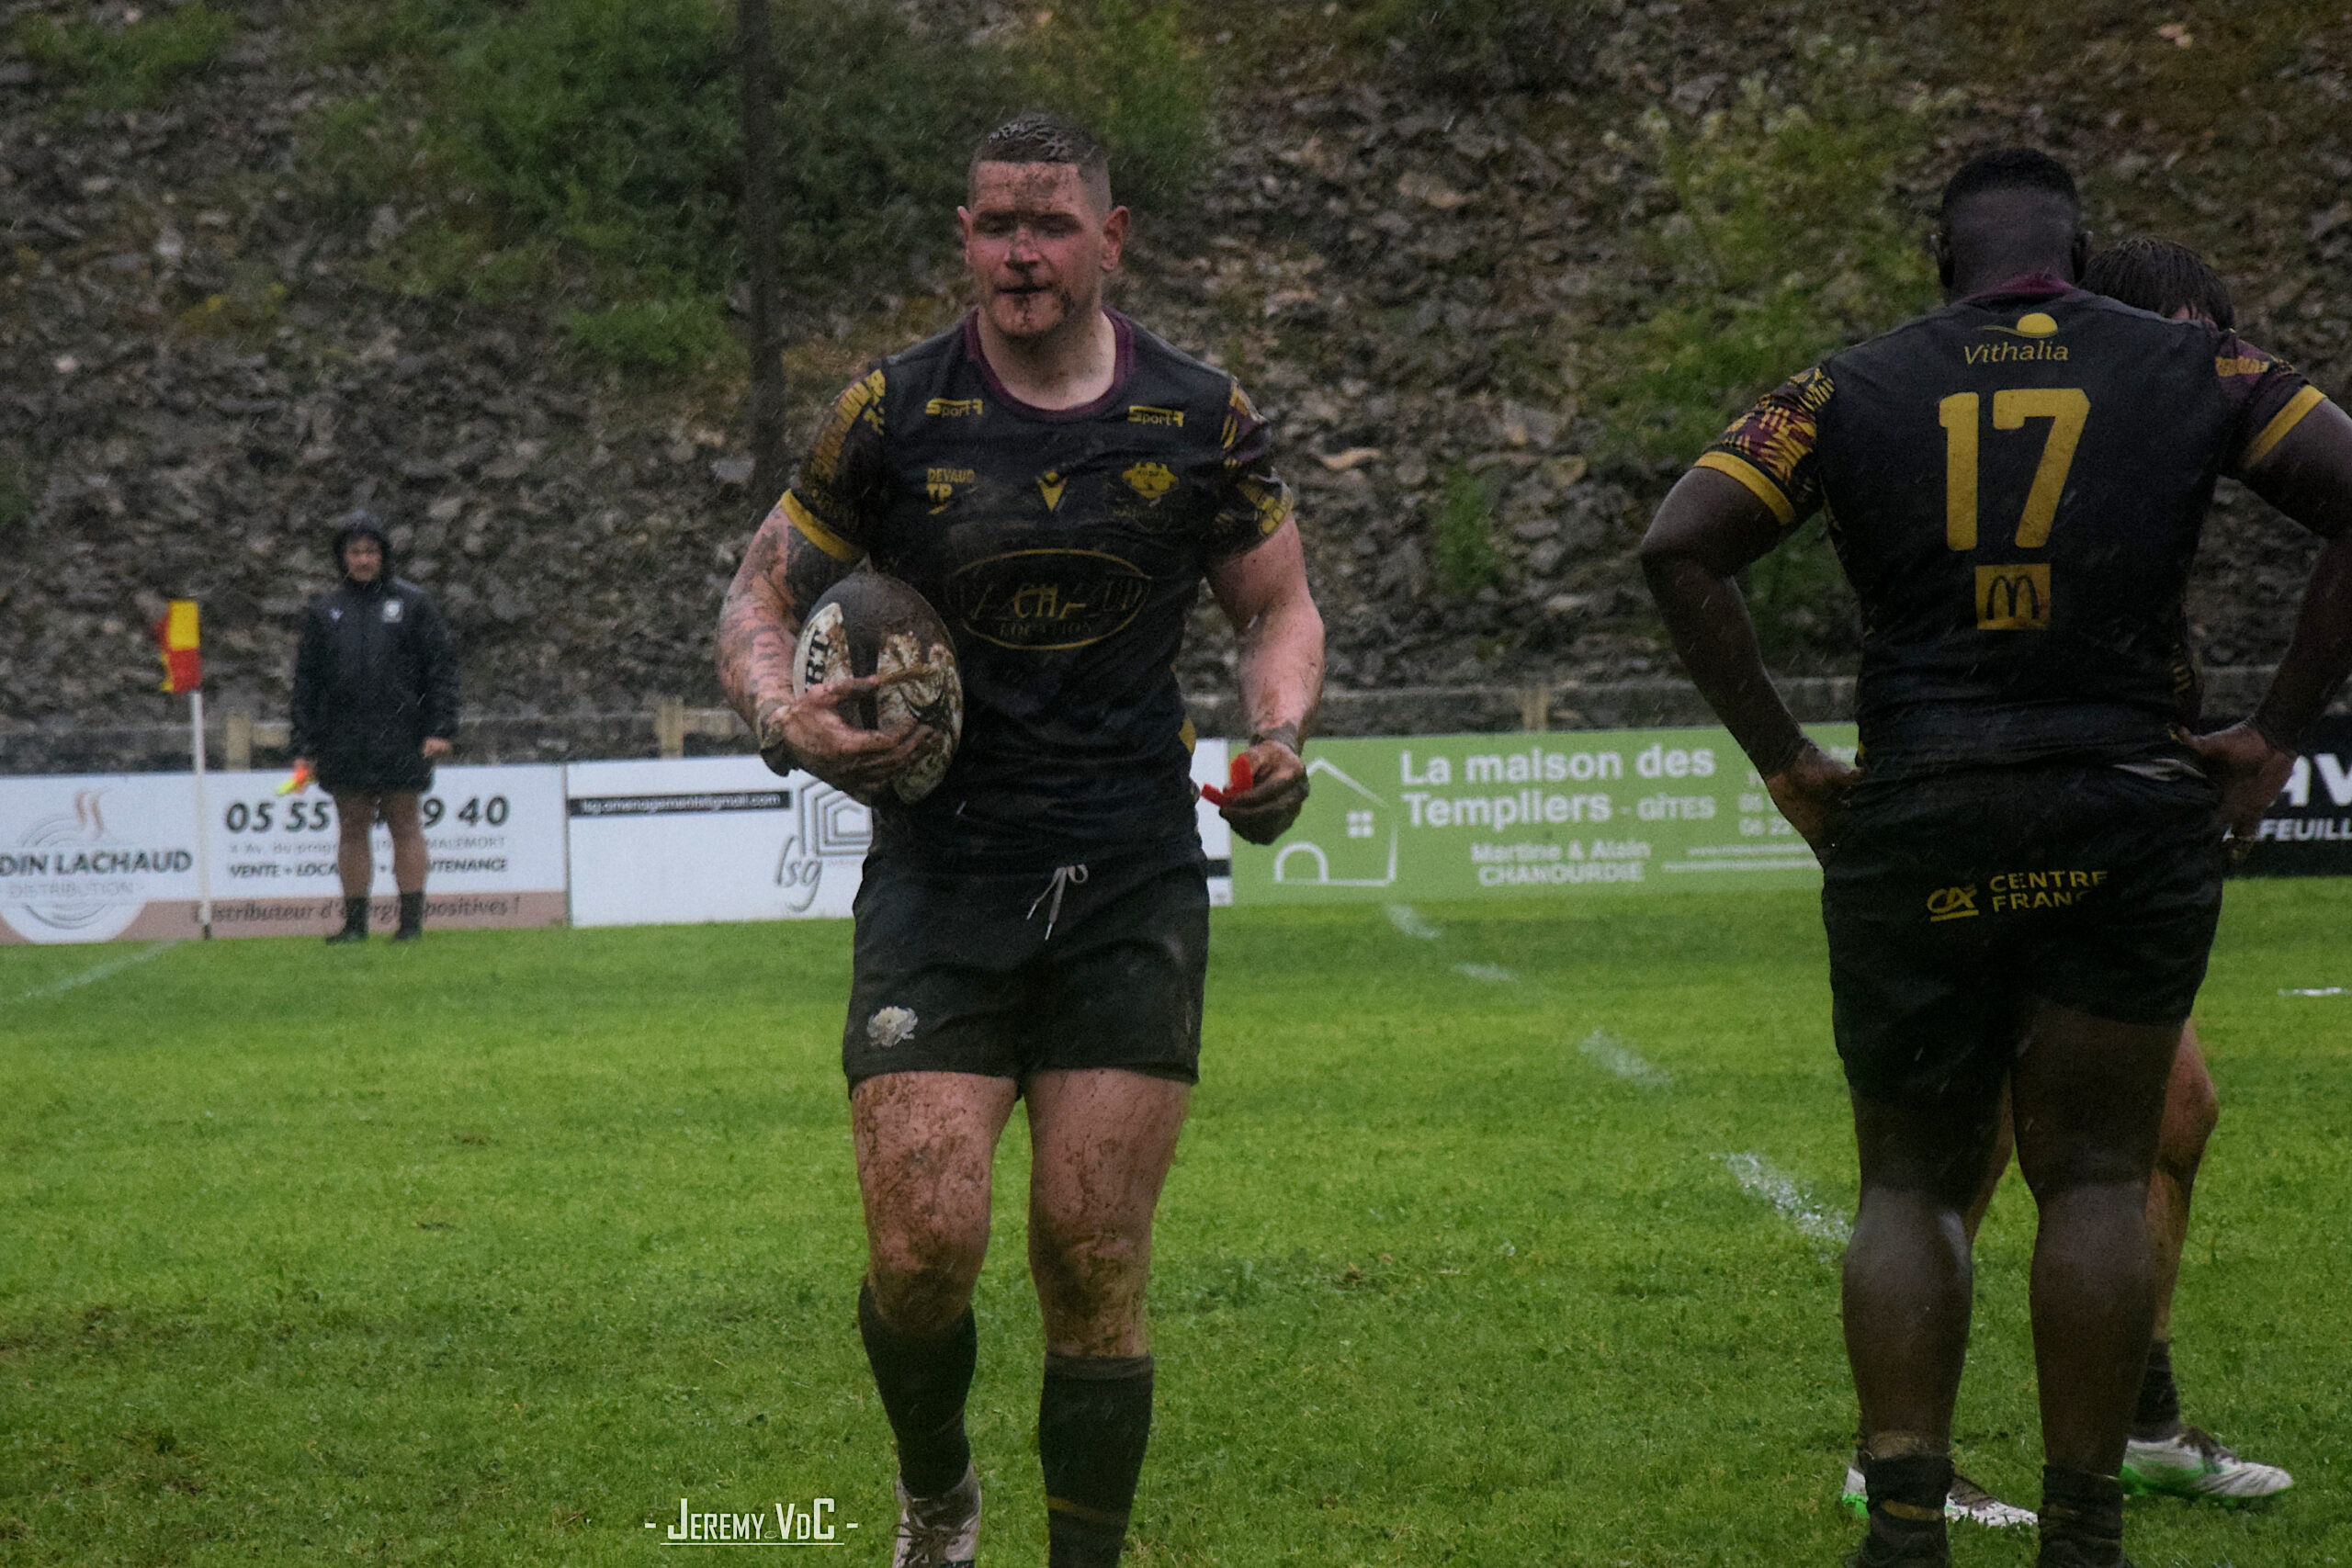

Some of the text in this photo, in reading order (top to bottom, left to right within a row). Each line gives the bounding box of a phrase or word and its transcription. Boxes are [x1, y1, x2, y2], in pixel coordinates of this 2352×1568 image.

[1964, 340, 2069, 365] Vithalia
[927, 467, 976, 483] DEVAUD
[1939, 388, 2092, 552] 17
[926, 483, 953, 502] TP
[1400, 750, 1452, 784] La
[1465, 747, 1624, 784] maison
[1635, 743, 1716, 778] des
[226, 796, 510, 831] 05 55 9 40
[1400, 789, 1612, 832] Templiers
[55, 851, 192, 874] LACHAUD
[230, 863, 279, 877] VENTE
[296, 863, 340, 876] LOCA
[1992, 890, 2091, 912] FRAN
